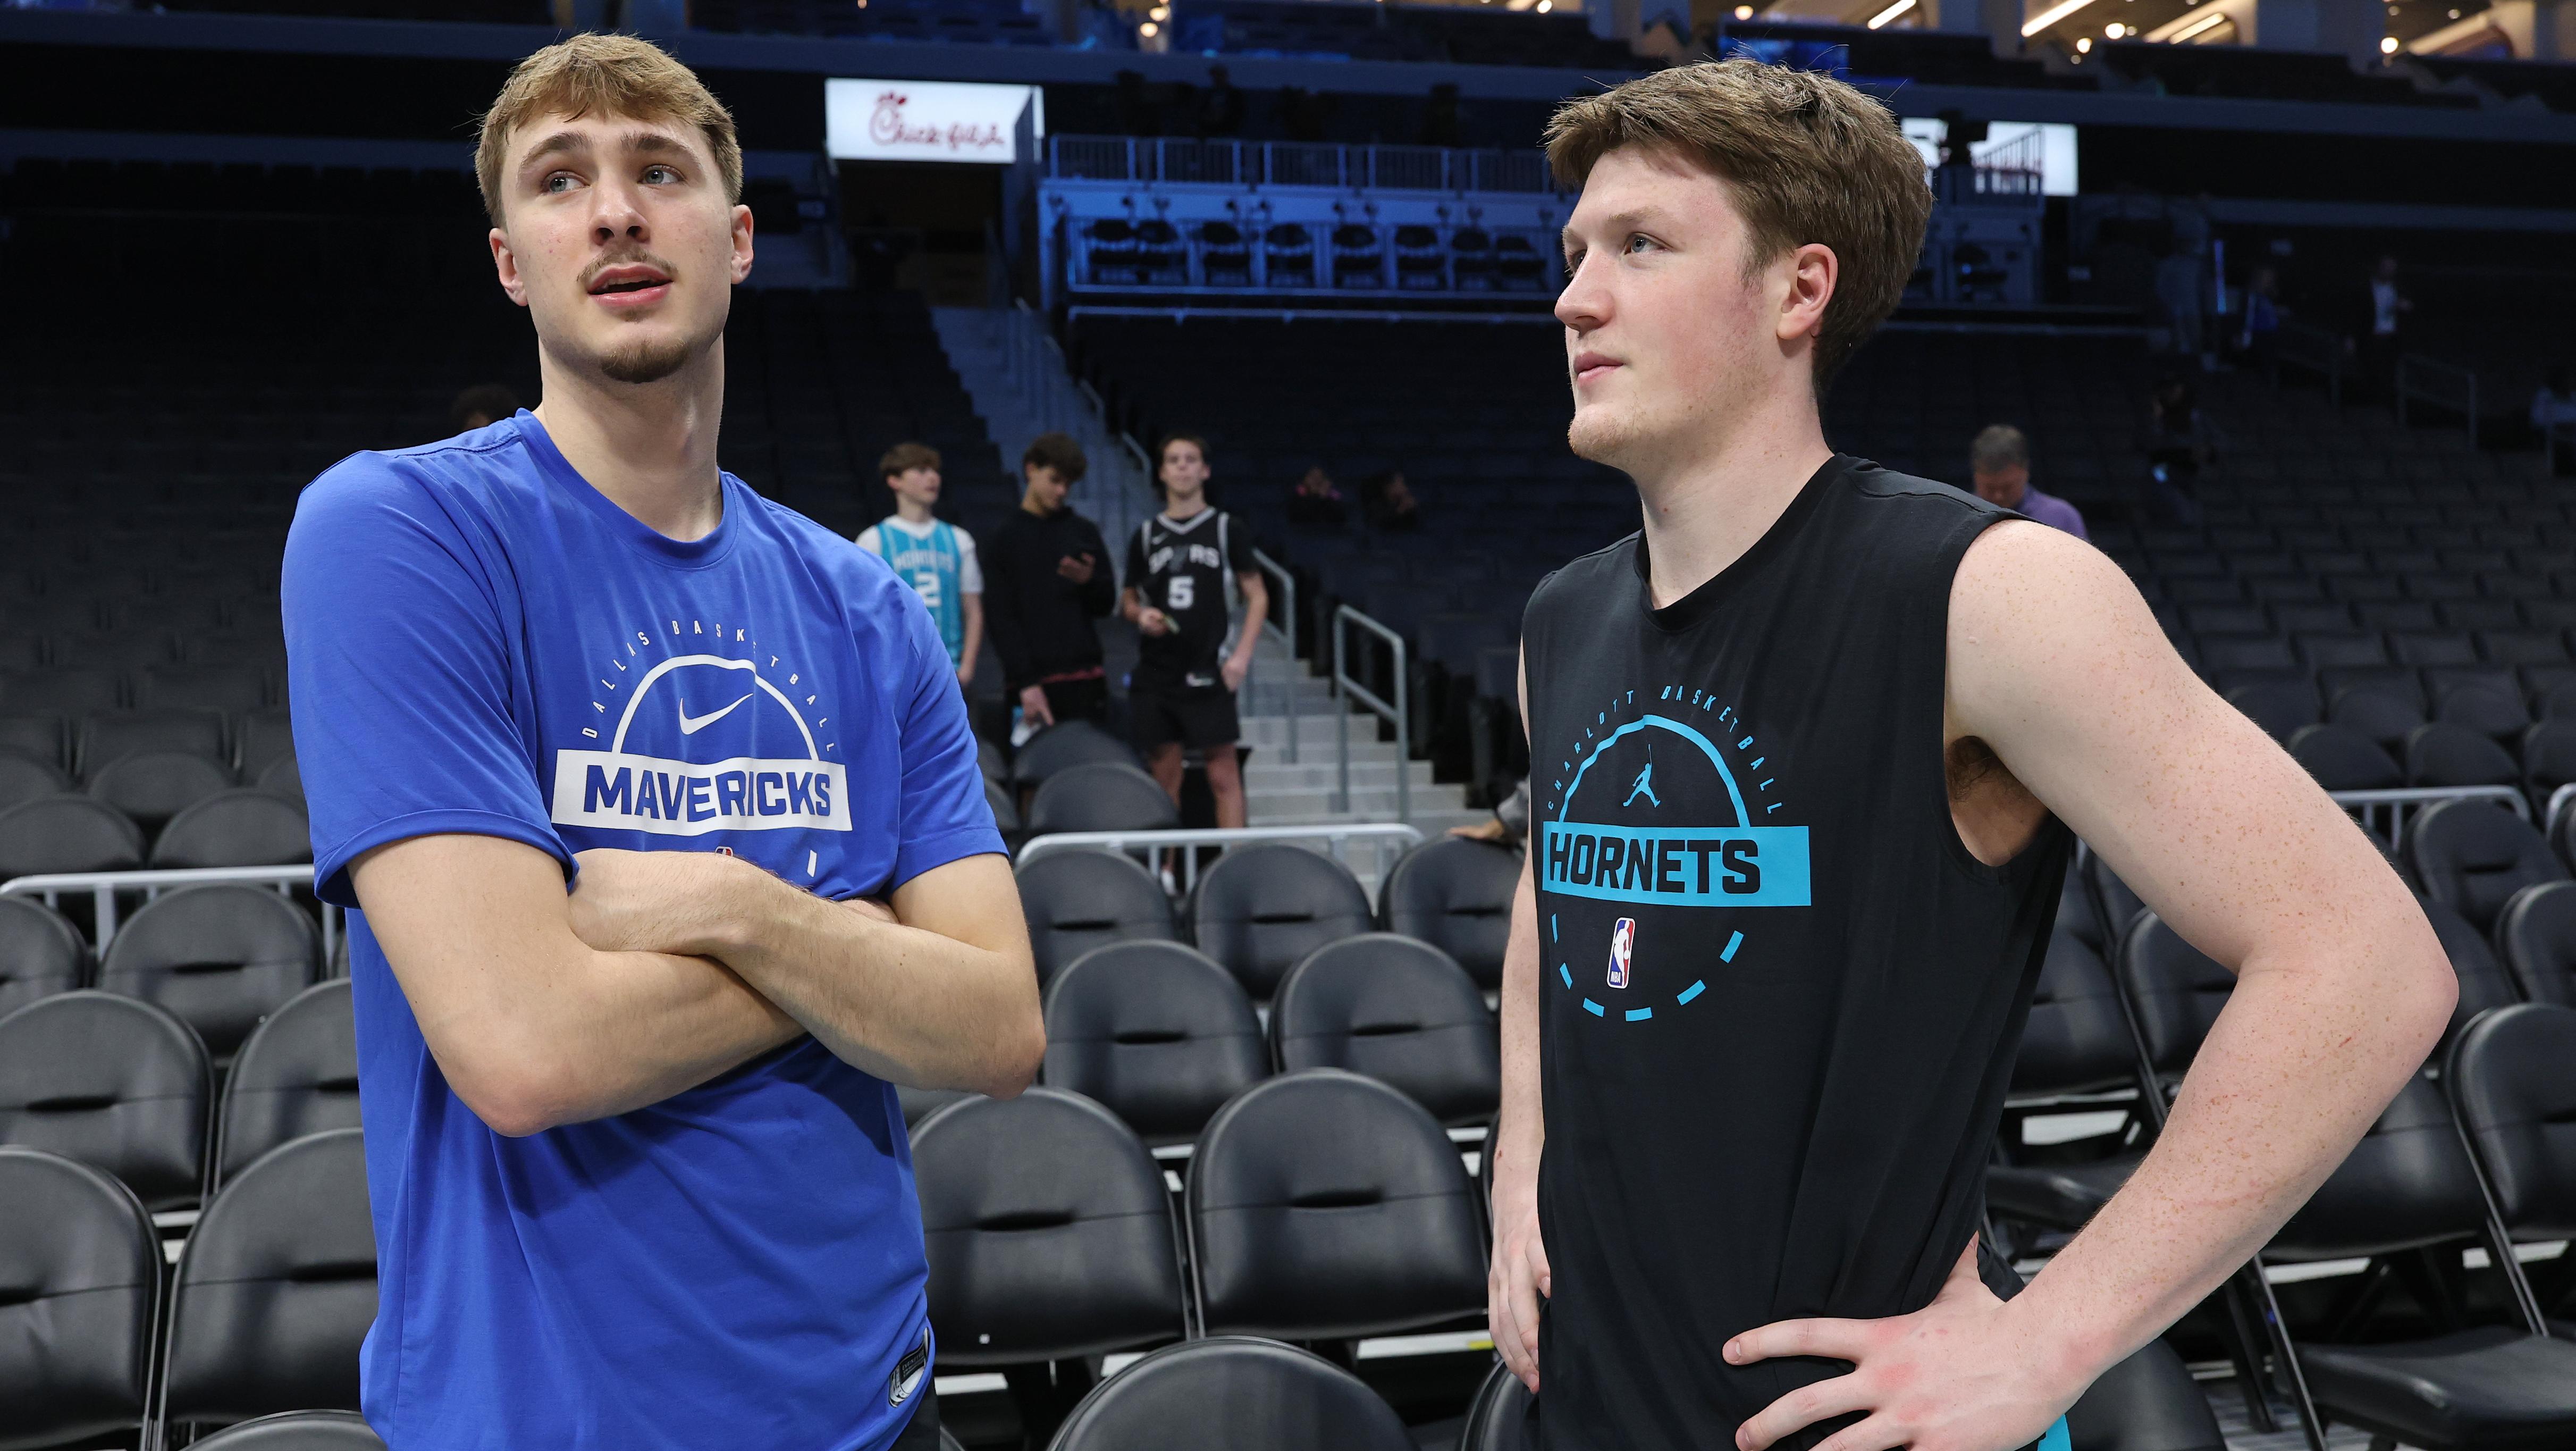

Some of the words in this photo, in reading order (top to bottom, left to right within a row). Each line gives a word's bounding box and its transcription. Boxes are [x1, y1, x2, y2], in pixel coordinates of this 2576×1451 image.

[914, 572, 941, 607] 2
[1168, 575, 1194, 609] 5
[582, 631, 650, 739] DALLAS
[1660, 685, 1782, 815] BASKETBALL
[584, 764, 831, 823] MAVERICKS
[1549, 832, 1761, 894] HORNETS
[1610, 971, 1621, 983] NBA
